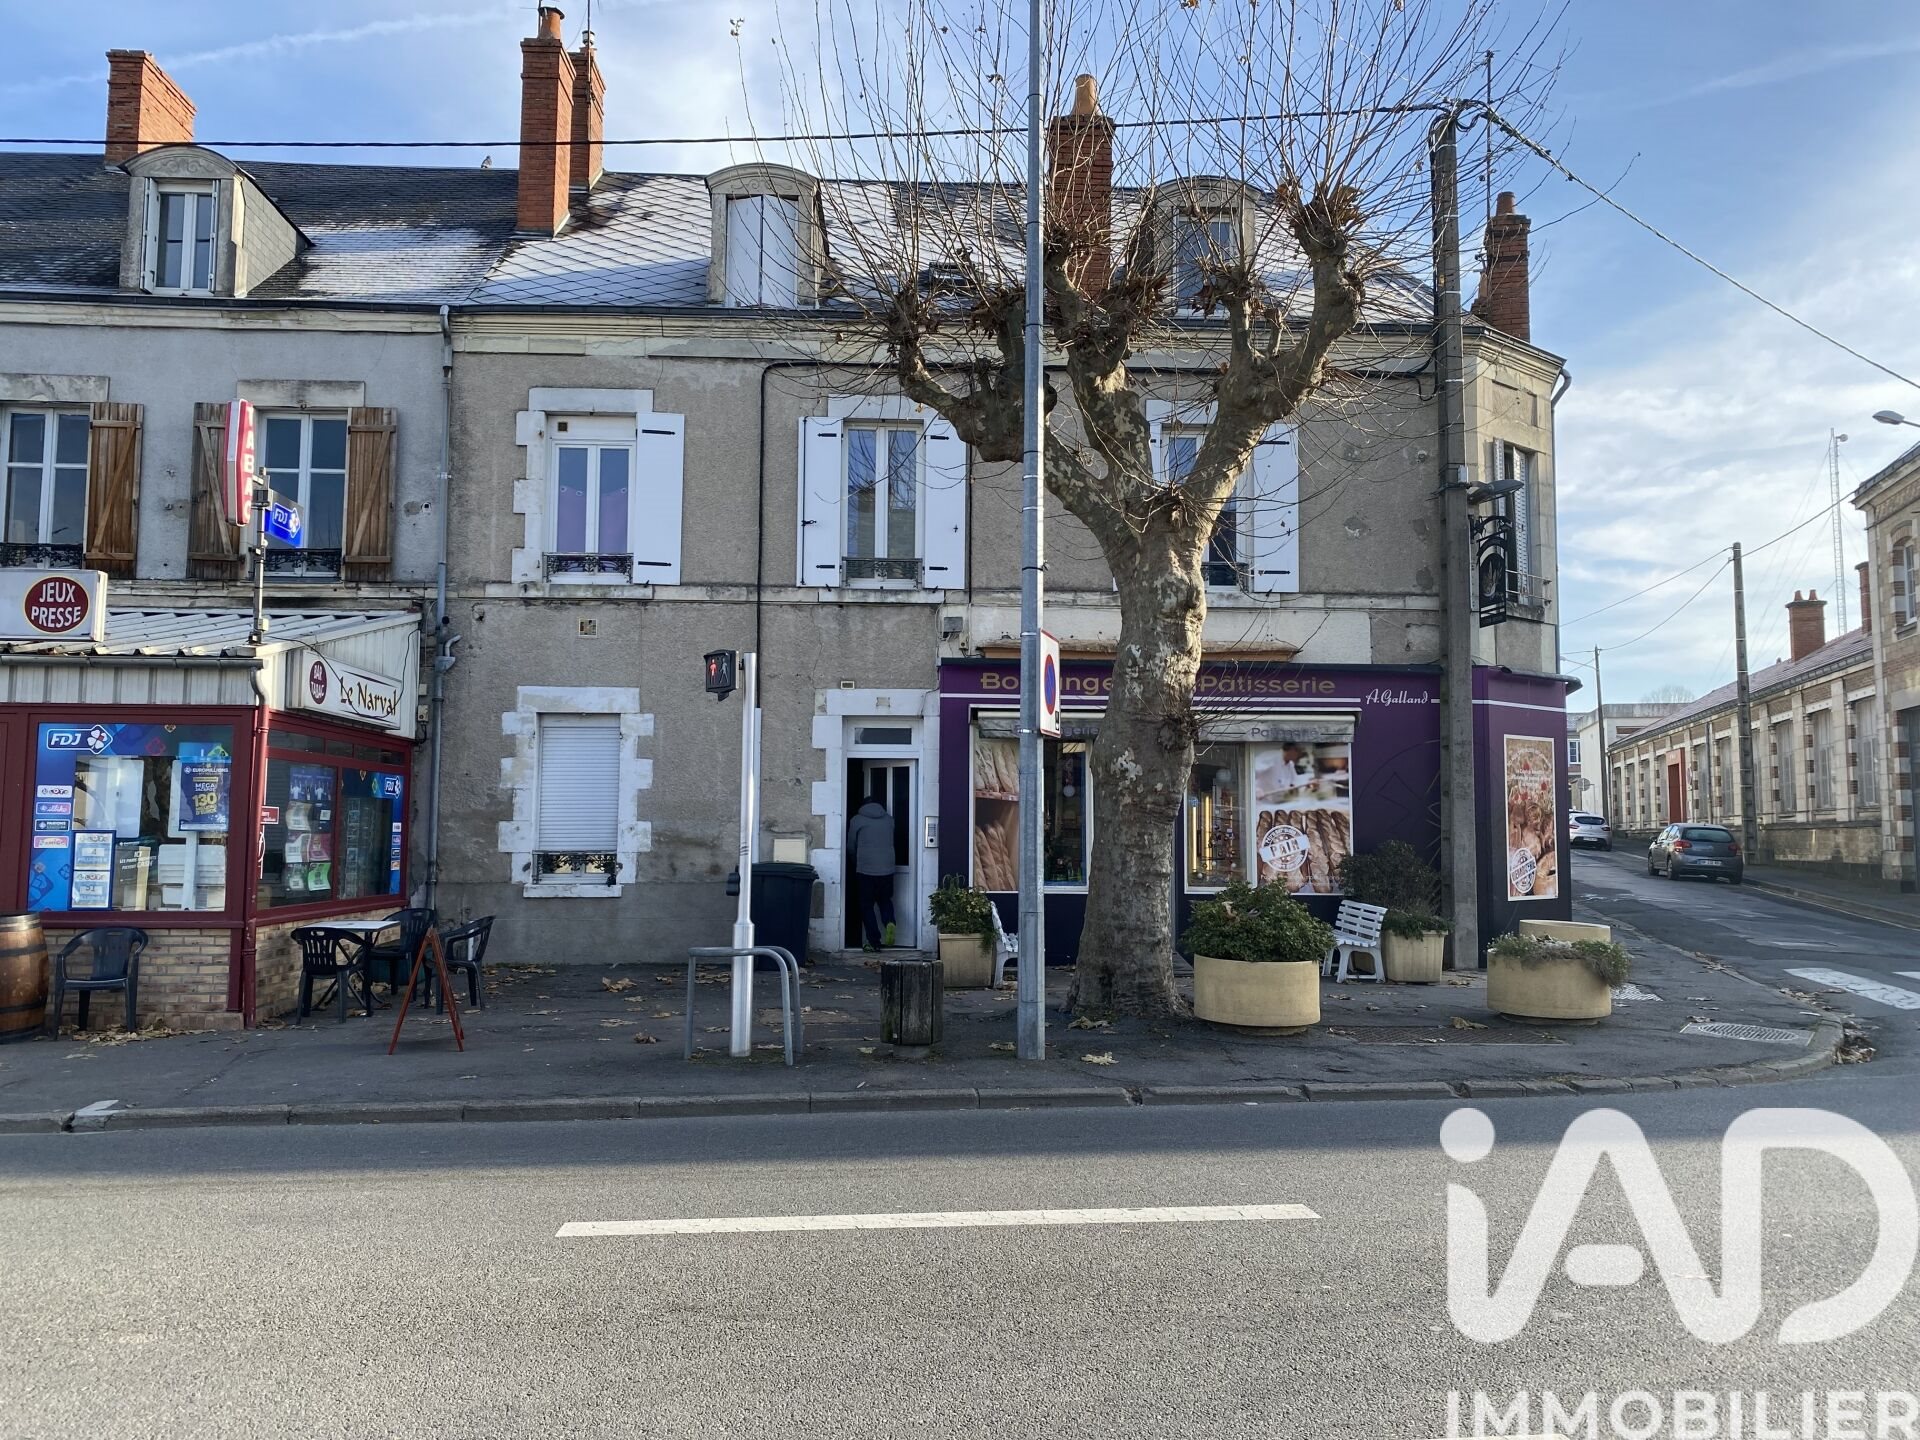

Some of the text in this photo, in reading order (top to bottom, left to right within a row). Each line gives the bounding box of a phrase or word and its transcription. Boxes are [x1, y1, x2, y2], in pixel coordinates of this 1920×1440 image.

[243, 405, 255, 522] TABAC
[274, 508, 288, 524] FDJ
[39, 581, 76, 603] JEUX
[31, 606, 82, 628] PRESSE
[310, 681, 324, 699] TABAC
[1199, 674, 1336, 693] Pâtisserie
[357, 681, 397, 716] Narval
[1365, 688, 1429, 707] A.Galland
[50, 733, 81, 745] FDJ
[192, 792, 217, 807] 130
[1270, 839, 1300, 857] PAIN
